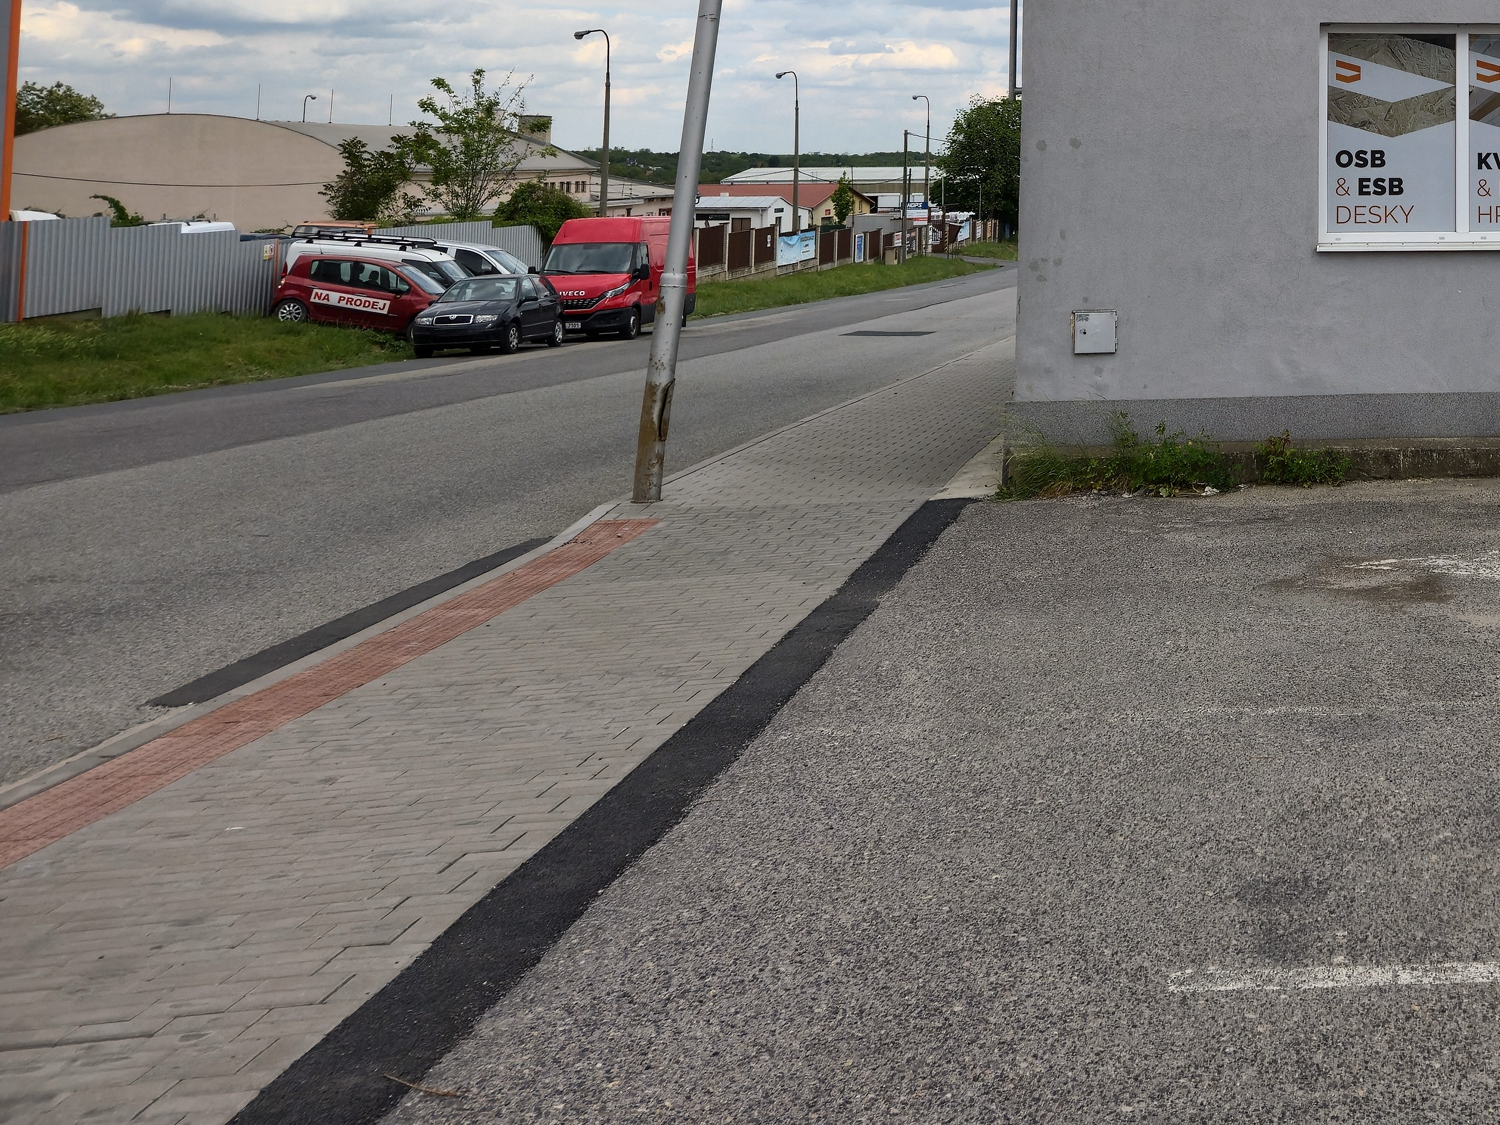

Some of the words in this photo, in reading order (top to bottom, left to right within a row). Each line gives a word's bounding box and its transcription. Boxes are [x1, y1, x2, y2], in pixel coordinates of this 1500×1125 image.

[1335, 149, 1386, 168] OSB
[1335, 178, 1350, 196] &
[1358, 178, 1404, 196] ESB
[1477, 179, 1492, 197] &
[1336, 205, 1414, 224] DESKY
[313, 291, 330, 302] NA
[337, 295, 387, 311] PRODEJ
